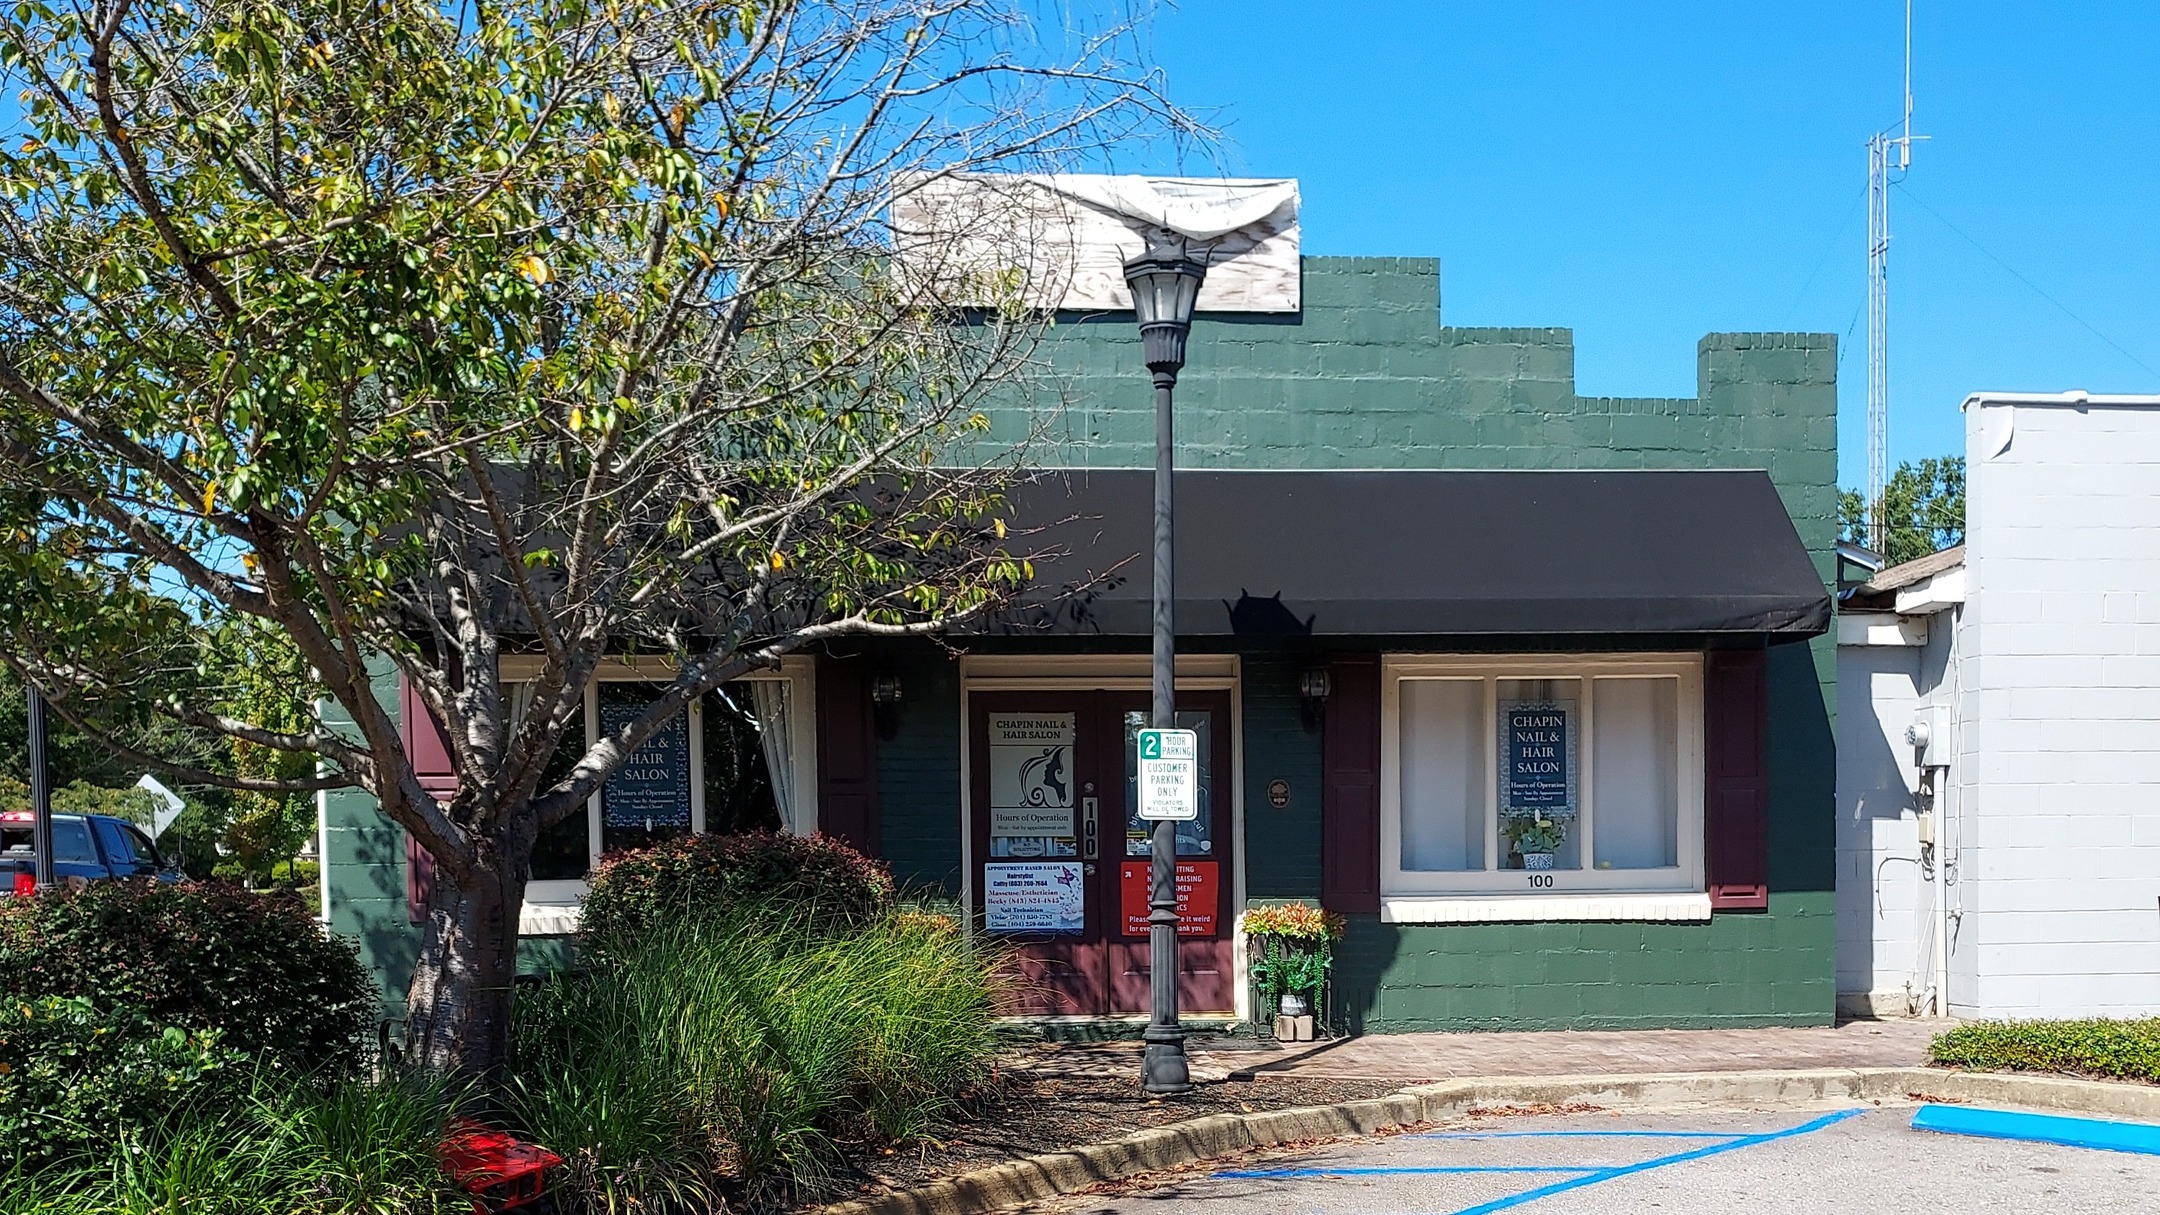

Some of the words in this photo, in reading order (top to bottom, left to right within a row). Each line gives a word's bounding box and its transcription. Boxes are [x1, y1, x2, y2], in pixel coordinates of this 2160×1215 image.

[996, 720, 1034, 729] CHAPIN
[1035, 720, 1059, 729] NAIL
[1060, 721, 1067, 729] &
[1513, 716, 1563, 727] CHAPIN
[1003, 731, 1028, 739] HAIR
[1028, 731, 1061, 739] SALON
[1167, 736, 1186, 745] HOUR
[1516, 731, 1547, 742] NAIL
[1549, 731, 1560, 742] &
[658, 737, 669, 748] &
[1145, 735, 1157, 756] 2
[1162, 747, 1191, 756] PARKING
[1522, 747, 1555, 758] HAIR
[630, 753, 664, 764] HAIR
[1147, 763, 1188, 773] CUSTOMER
[1517, 762, 1560, 773] SALON
[624, 769, 669, 780] SALON
[1151, 775, 1185, 785] PARKING
[1536, 781, 1565, 790] Operation
[645, 789, 677, 797] Operation
[1157, 787, 1178, 797] ONLY
[1021, 813, 1029, 821] of
[1030, 814, 1069, 823] Operation
[1086, 801, 1096, 856] 100
[1193, 819, 1205, 833] cut
[1527, 874, 1553, 888] 100
